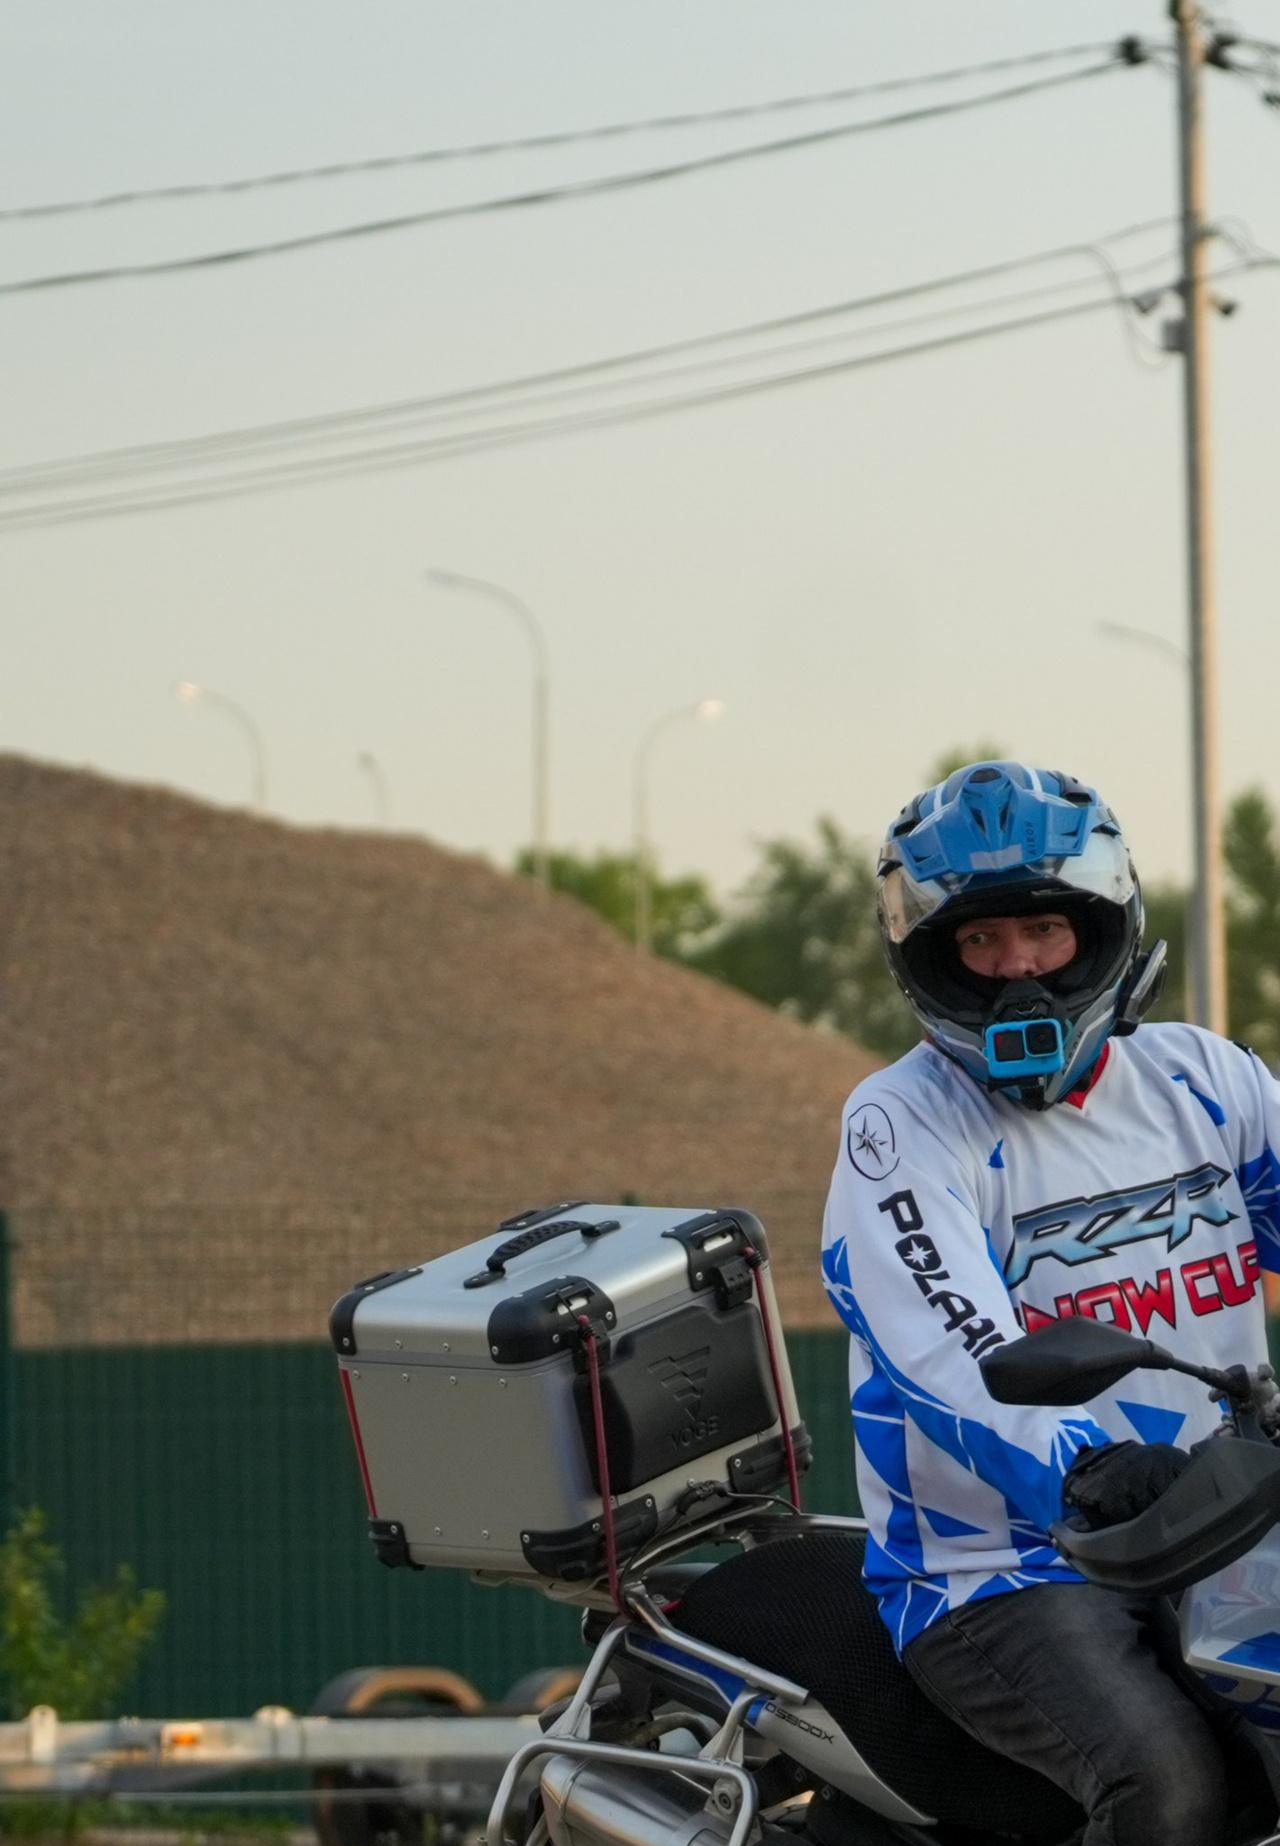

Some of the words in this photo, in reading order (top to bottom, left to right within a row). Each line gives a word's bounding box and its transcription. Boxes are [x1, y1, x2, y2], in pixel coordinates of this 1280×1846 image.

[1025, 821, 1037, 856] AIROH
[1004, 1162, 1240, 1290] RZR
[1180, 1239, 1261, 1316] CUP
[670, 1415, 720, 1451] VOGE
[764, 1701, 835, 1744] DS900X
